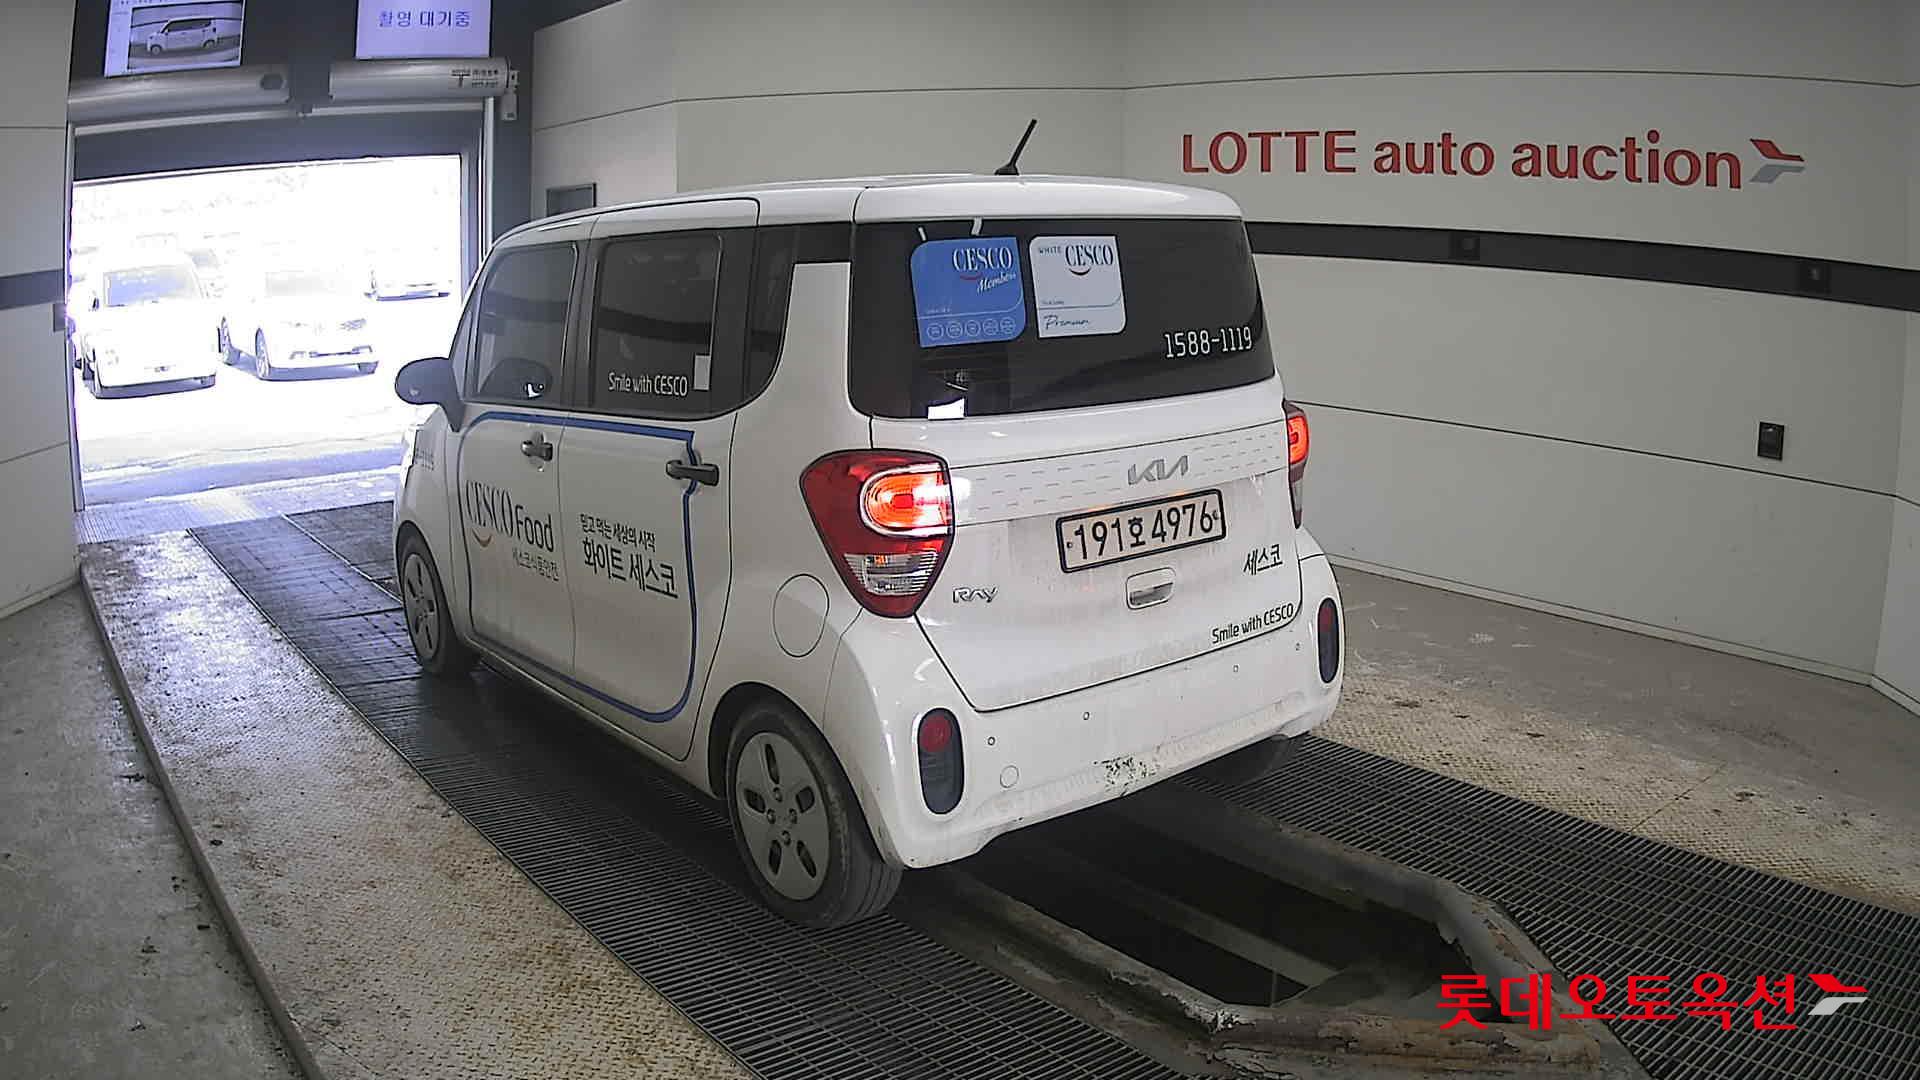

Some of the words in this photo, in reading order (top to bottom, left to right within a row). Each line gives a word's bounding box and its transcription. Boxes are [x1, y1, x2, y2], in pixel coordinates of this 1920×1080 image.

[420, 11, 469, 27] 대기중
[1183, 130, 1357, 174] LOTTE
[1373, 133, 1495, 176] auto
[1512, 130, 1742, 189] auction
[952, 246, 1013, 271] CESCO
[1065, 244, 1114, 266] CESCO
[1164, 326, 1253, 358] 1588-1119
[608, 371, 631, 392] Smile
[633, 373, 652, 393] with
[654, 375, 688, 396] CESCO
[465, 480, 514, 537] CESCO
[515, 504, 554, 552] Food
[1074, 514, 1146, 561] 191호
[1151, 500, 1213, 543] 4976
[582, 536, 626, 580] 화이트
[629, 553, 678, 599] 세스코
[1243, 544, 1284, 576] 세스코
[1212, 618, 1239, 645] Smile
[1241, 614, 1262, 635] with
[1263, 602, 1294, 628] CESCO
